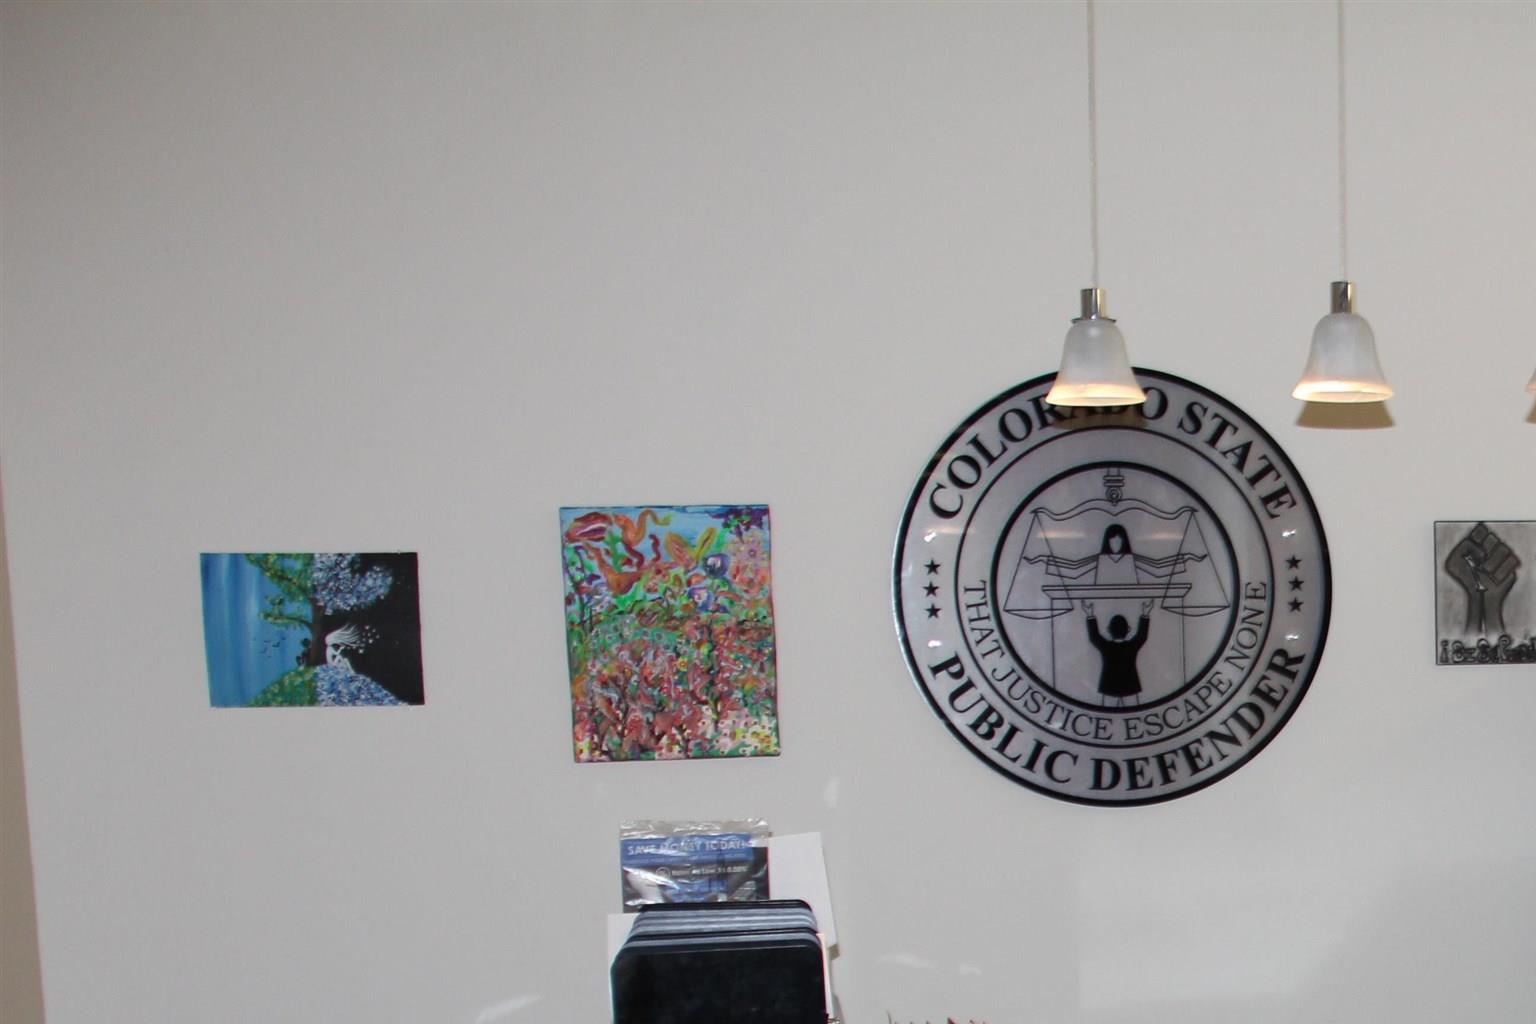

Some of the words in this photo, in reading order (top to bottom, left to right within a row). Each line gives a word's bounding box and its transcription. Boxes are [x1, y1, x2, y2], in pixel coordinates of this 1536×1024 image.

[1177, 401, 1297, 521] STATE
[929, 651, 1079, 784] PUBLIC
[1087, 647, 1307, 792] DEFENDER
[962, 578, 1004, 660] THAT
[991, 664, 1113, 741] JUSTICE
[1124, 670, 1233, 741] ESCAPE
[1223, 580, 1268, 674] NONE
[627, 845, 657, 855] SAVE
